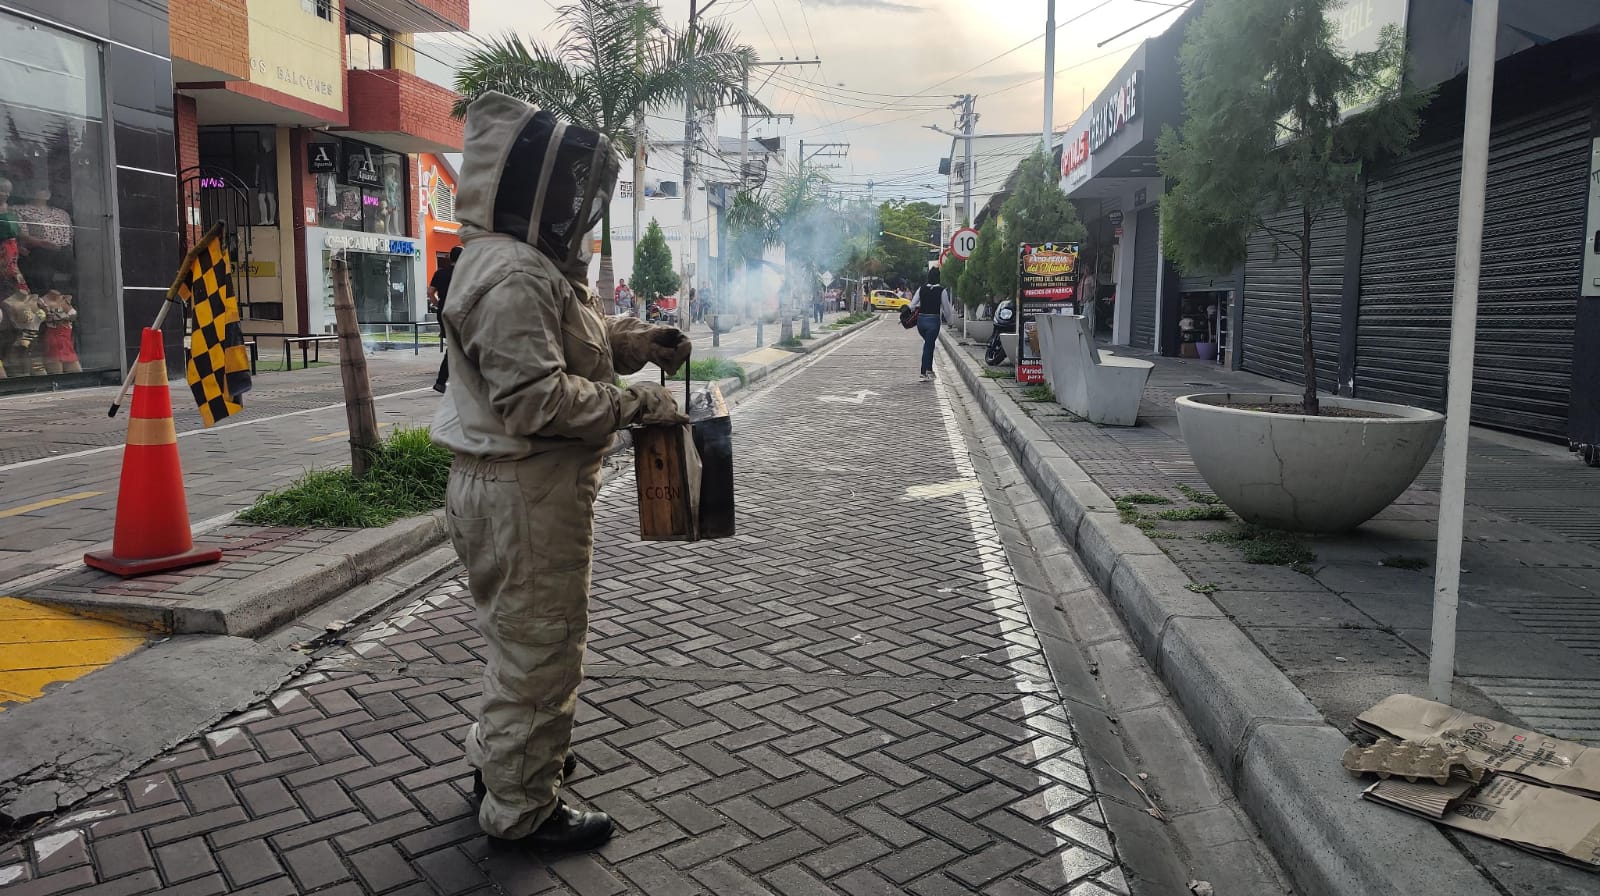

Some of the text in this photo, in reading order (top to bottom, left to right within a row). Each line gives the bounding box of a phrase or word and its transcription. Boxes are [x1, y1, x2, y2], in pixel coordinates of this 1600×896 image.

[249, 57, 334, 96] OS BALCONES
[961, 237, 975, 251] 10
